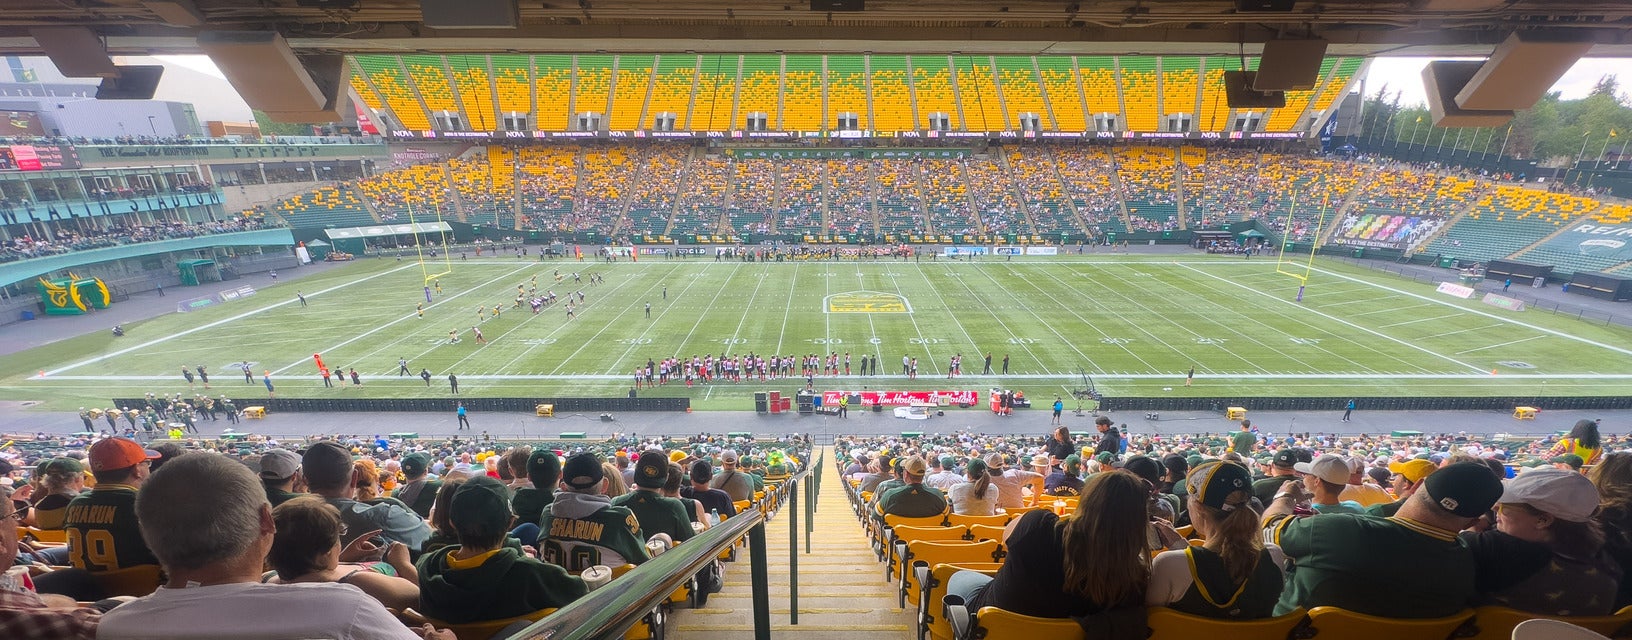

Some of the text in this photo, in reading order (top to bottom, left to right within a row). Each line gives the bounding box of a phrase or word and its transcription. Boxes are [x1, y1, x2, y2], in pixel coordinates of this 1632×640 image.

[876, 394, 892, 404] Tim
[892, 393, 925, 404] Hortons
[67, 504, 118, 524] SHARUN
[550, 519, 604, 542] SHARUN
